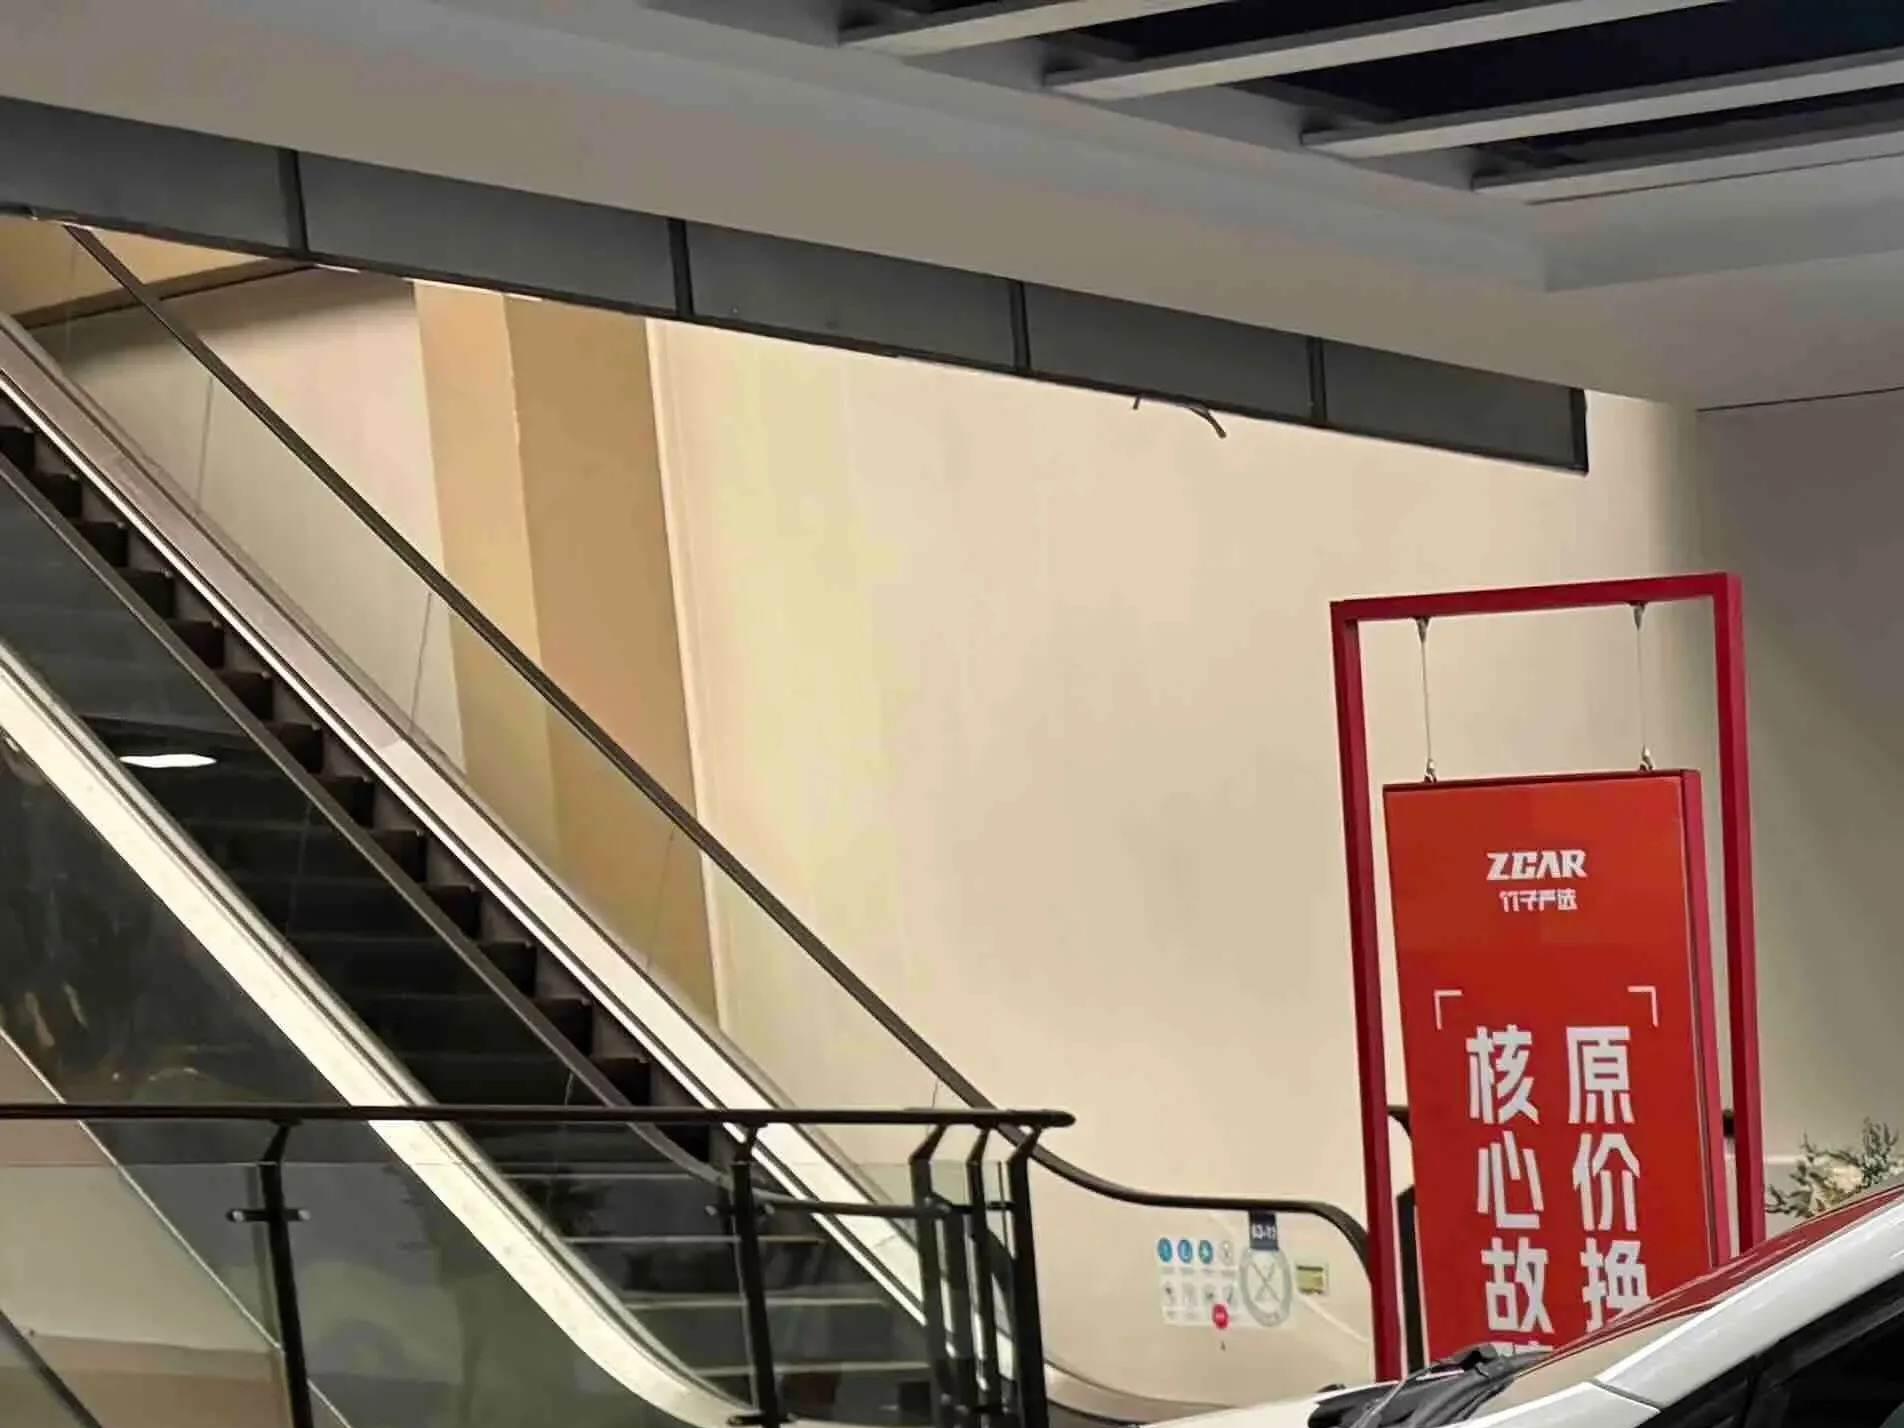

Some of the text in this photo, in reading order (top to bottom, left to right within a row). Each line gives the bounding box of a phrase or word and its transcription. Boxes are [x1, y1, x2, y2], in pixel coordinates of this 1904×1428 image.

[1486, 849, 1588, 881] ZCAR
[1466, 1024, 1555, 1356] 核心故
